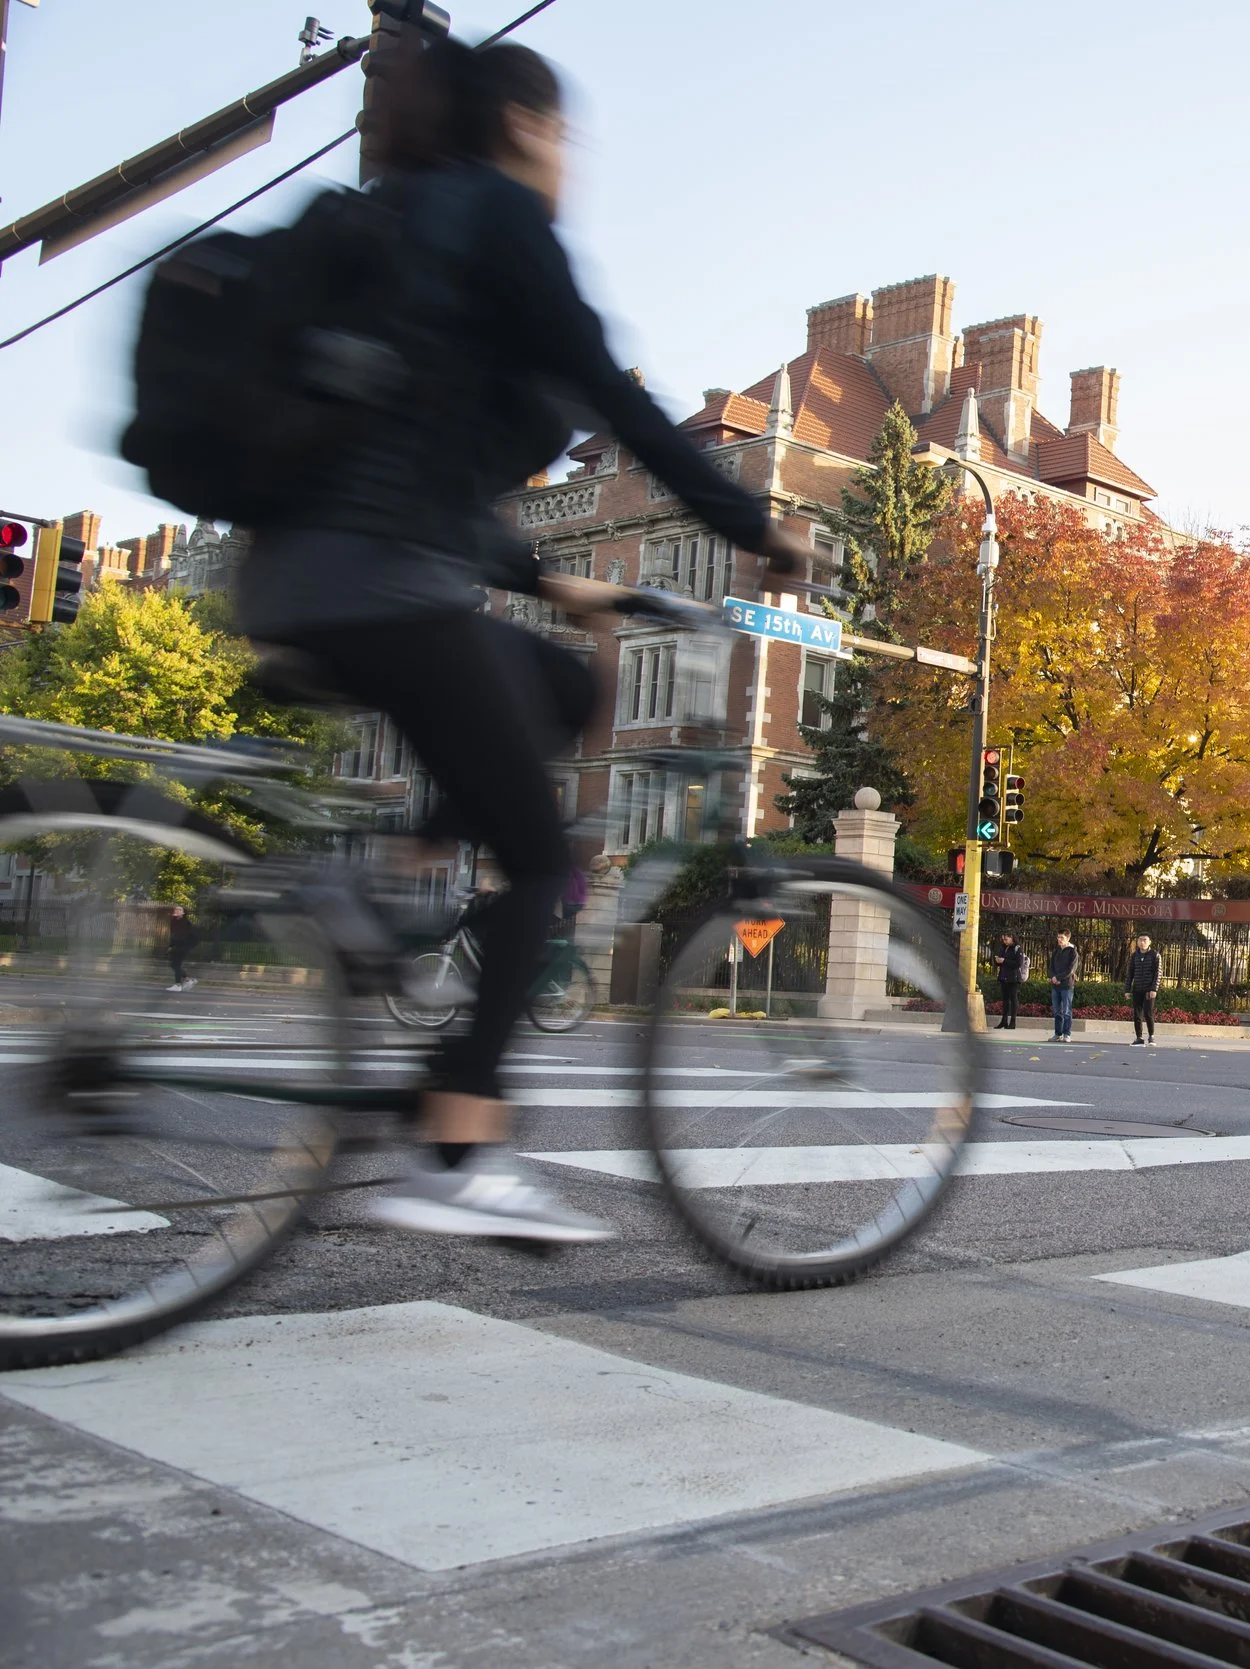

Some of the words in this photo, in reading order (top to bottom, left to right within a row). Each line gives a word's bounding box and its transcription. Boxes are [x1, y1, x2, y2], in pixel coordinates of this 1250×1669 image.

[731, 606, 756, 627] SE
[765, 614, 802, 636] 15th
[810, 625, 834, 643] Av
[956, 895, 967, 905] ONE
[981, 893, 1061, 912] UNIVERSITY
[1067, 901, 1085, 913] OF
[1092, 900, 1173, 917] MINNESOTA
[956, 906, 966, 915] WAY
[742, 928, 768, 939] AHEAD
